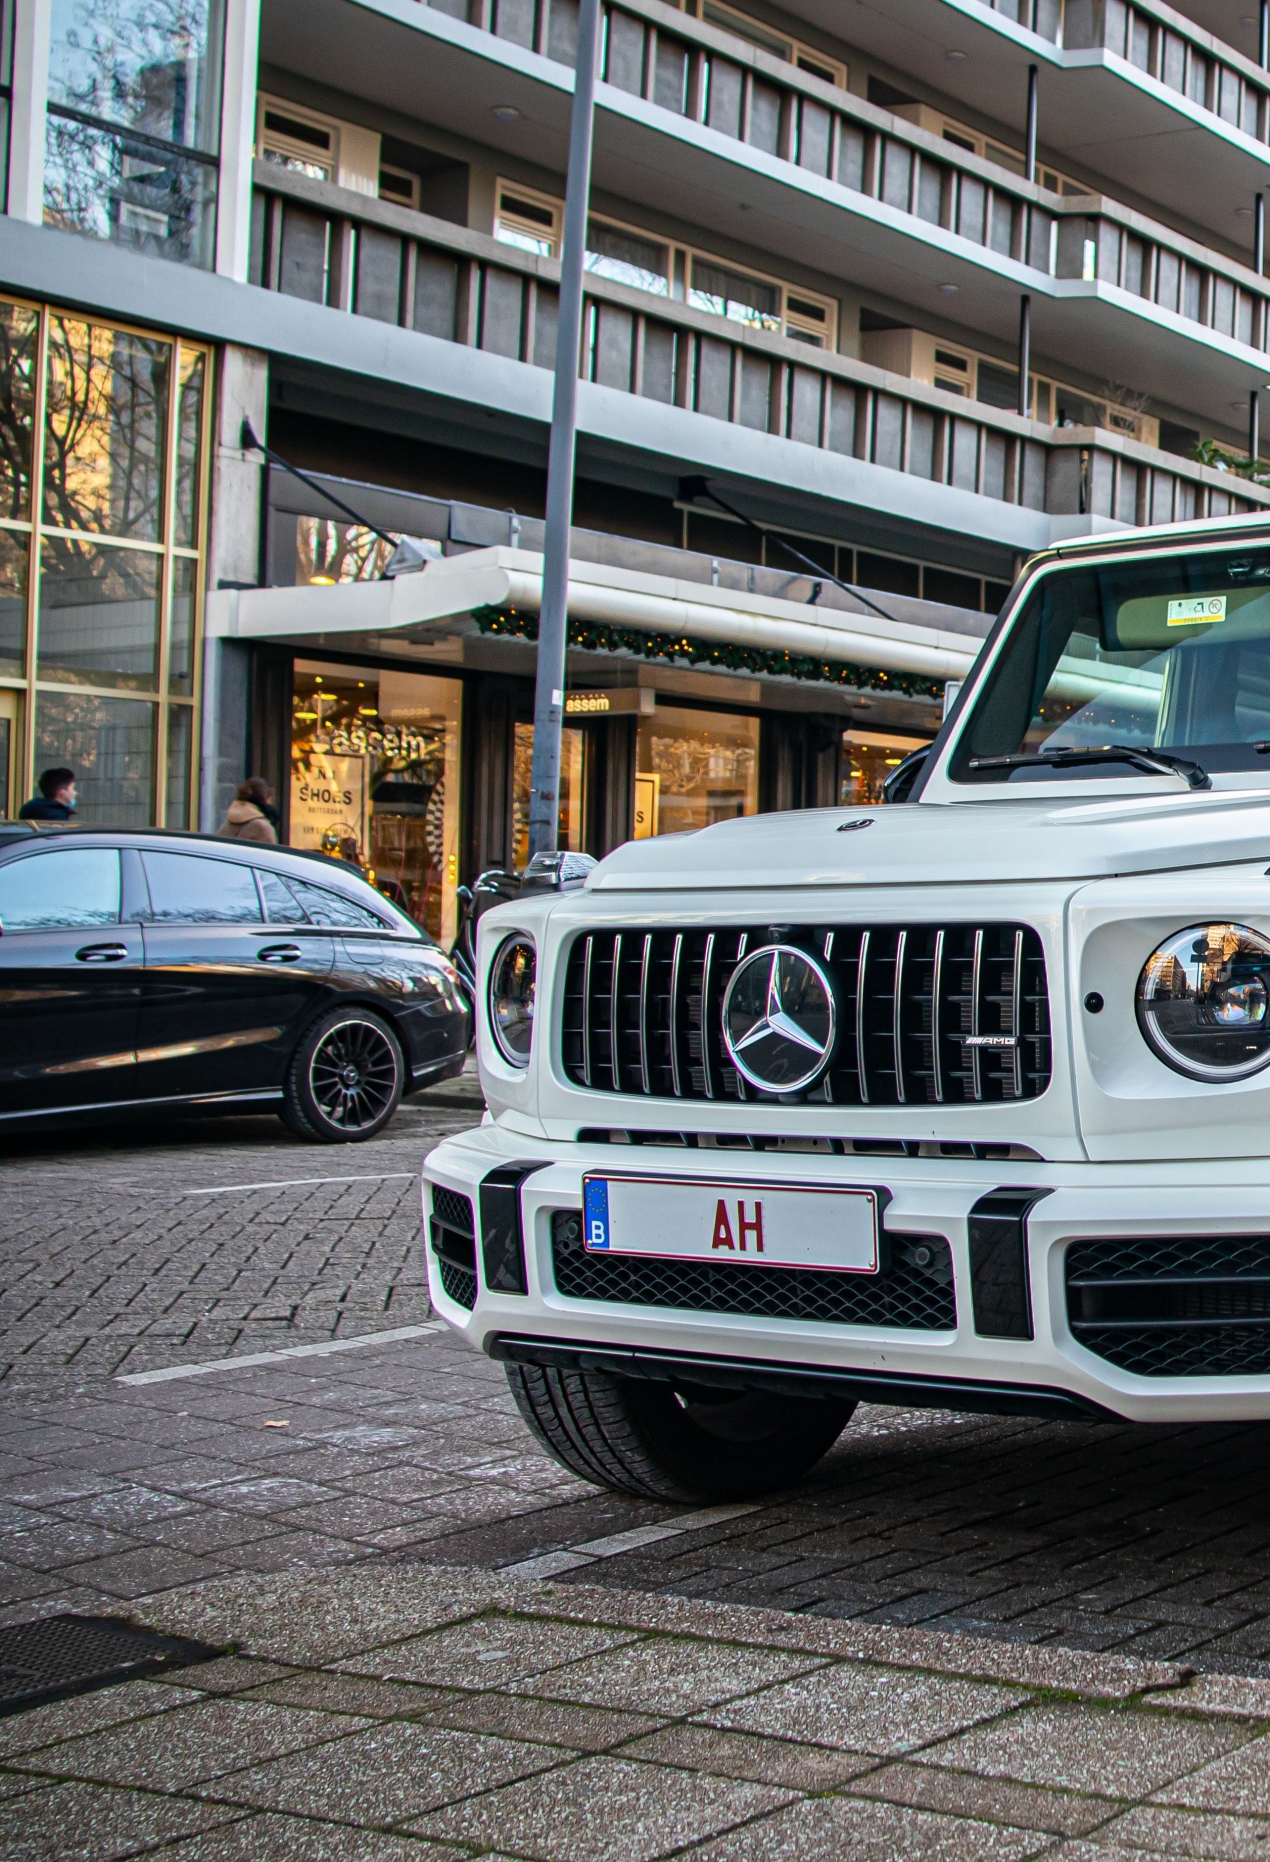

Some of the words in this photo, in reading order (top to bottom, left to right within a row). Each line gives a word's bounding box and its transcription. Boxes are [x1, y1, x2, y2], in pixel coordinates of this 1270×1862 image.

[565, 698, 609, 712] assem
[982, 1037, 1016, 1045] AMG
[591, 1220, 605, 1244] B
[711, 1198, 764, 1253] AH
